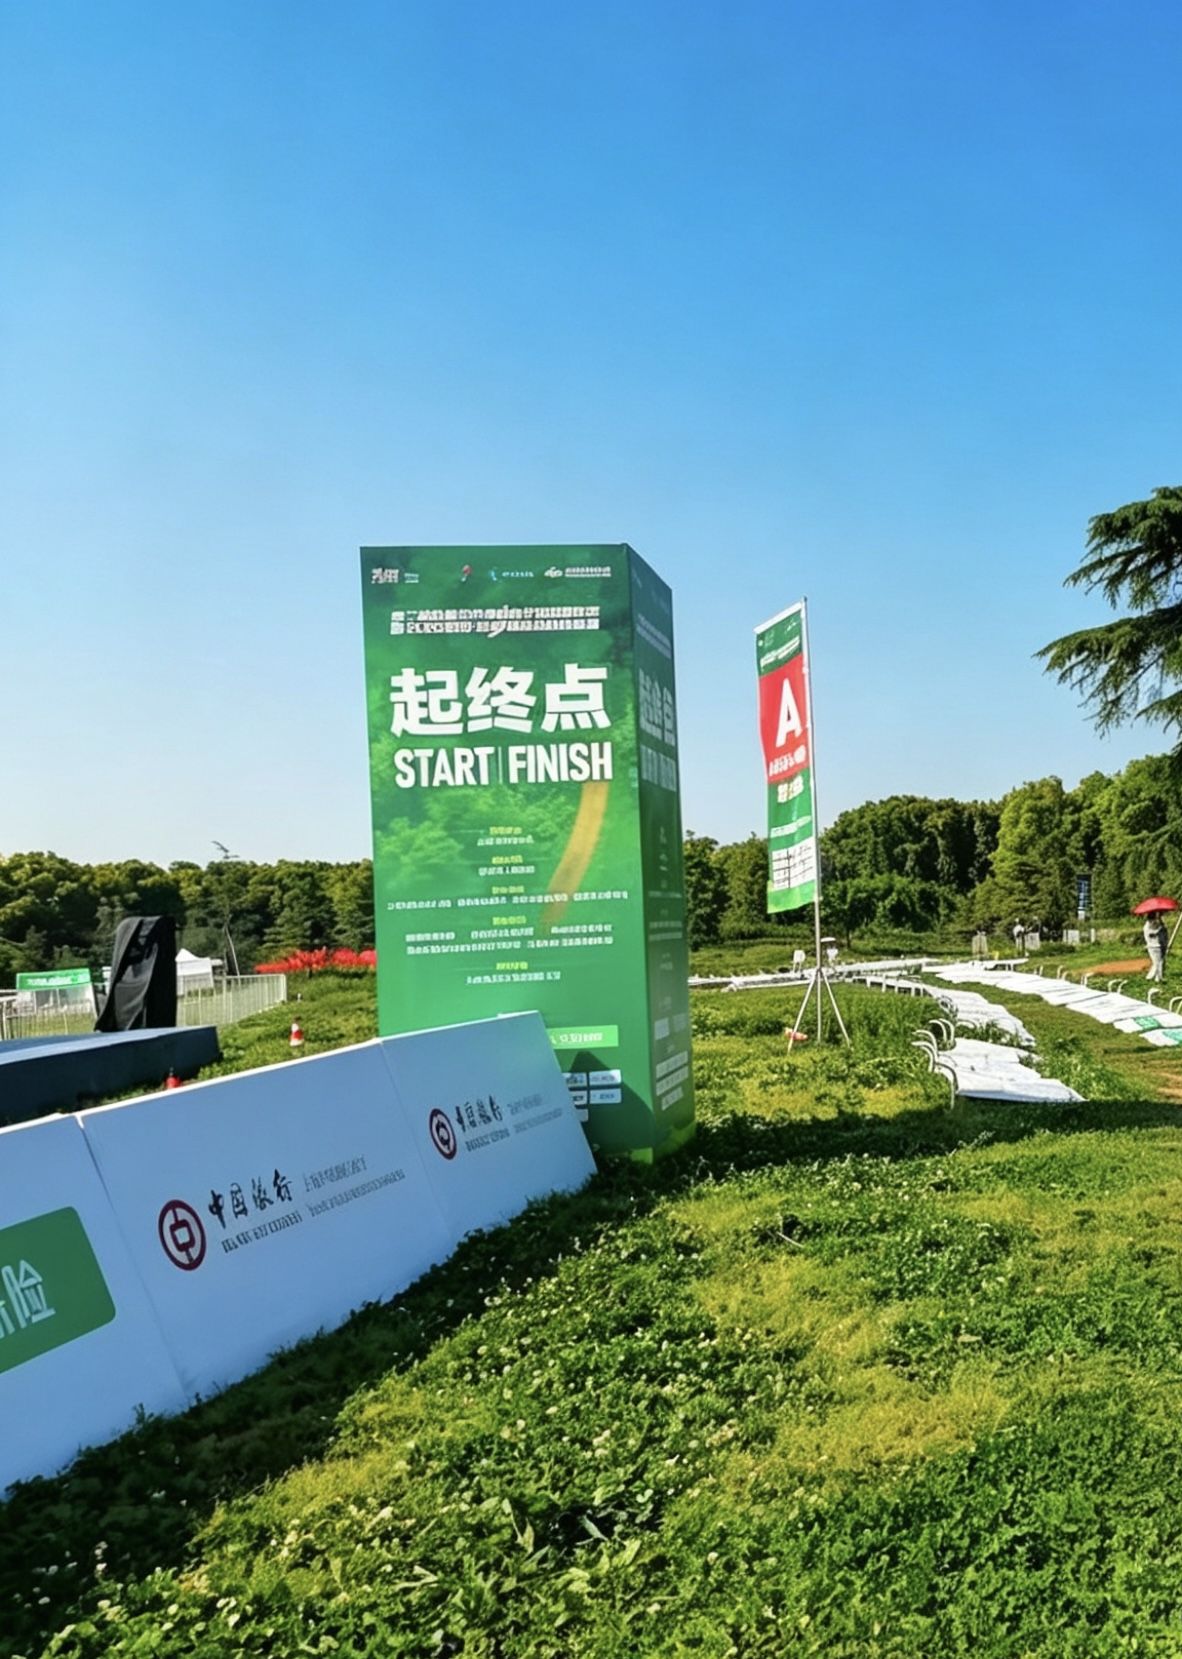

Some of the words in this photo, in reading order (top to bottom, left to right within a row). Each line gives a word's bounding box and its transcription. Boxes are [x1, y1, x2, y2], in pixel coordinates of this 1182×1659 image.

[389, 663, 612, 738] 起终点
[775, 677, 803, 748] A
[393, 746, 495, 789] START
[508, 741, 613, 784] FINISH
